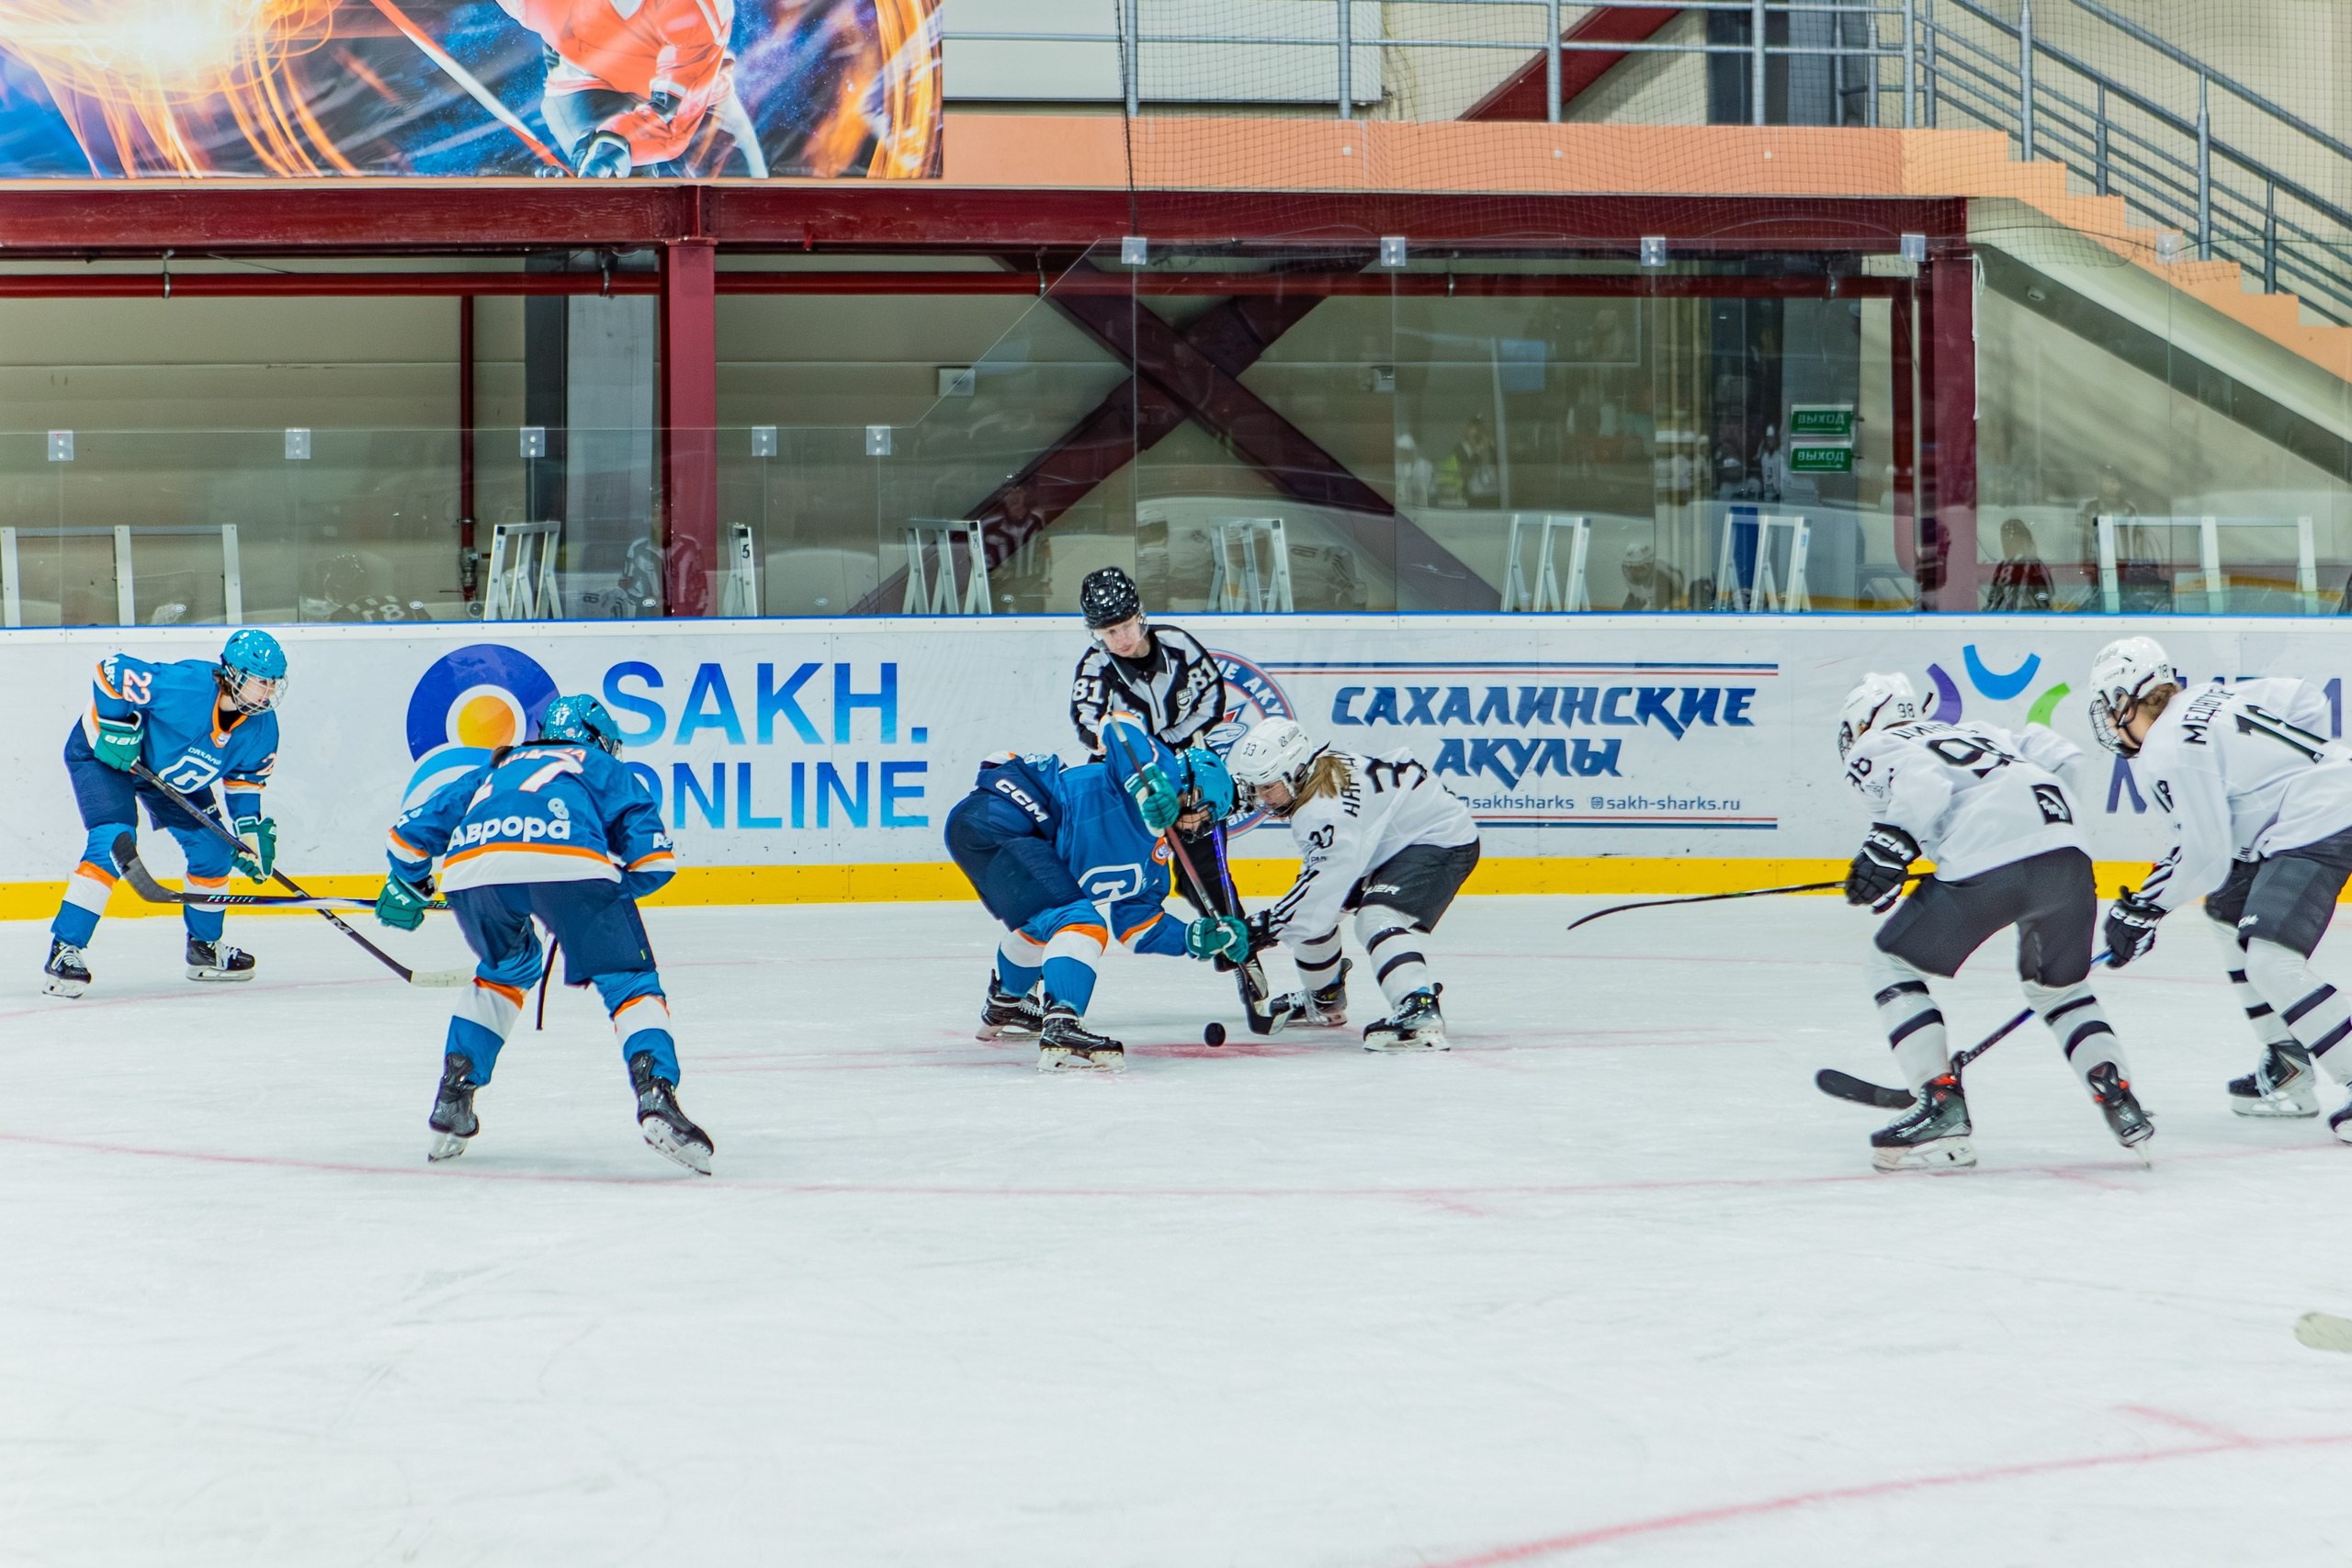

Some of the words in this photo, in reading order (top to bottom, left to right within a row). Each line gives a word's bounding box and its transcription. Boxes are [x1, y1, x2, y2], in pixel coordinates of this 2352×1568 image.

[1797, 413, 1846, 426] ВЫХОД
[1797, 450, 1846, 463] ВЫХОД
[122, 668, 153, 705] 22
[1187, 658, 1219, 692] 81
[2157, 663, 2169, 680] 18
[602, 660, 928, 745] SAKH.
[1071, 677, 1103, 705] 81
[1242, 677, 1285, 715] АКУ
[555, 705, 571, 727] 17
[1331, 685, 1757, 741] САХАЛИНСКИЕ
[1897, 703, 1915, 718] 98
[1242, 742, 1258, 757] 33
[1432, 738, 1623, 791] АКУЛЫ
[994, 778, 1050, 823] CCM
[1472, 795, 1575, 811] sakhsharks
[1606, 795, 1740, 811] sakh-sharks.ru
[447, 815, 571, 852] Аврора
